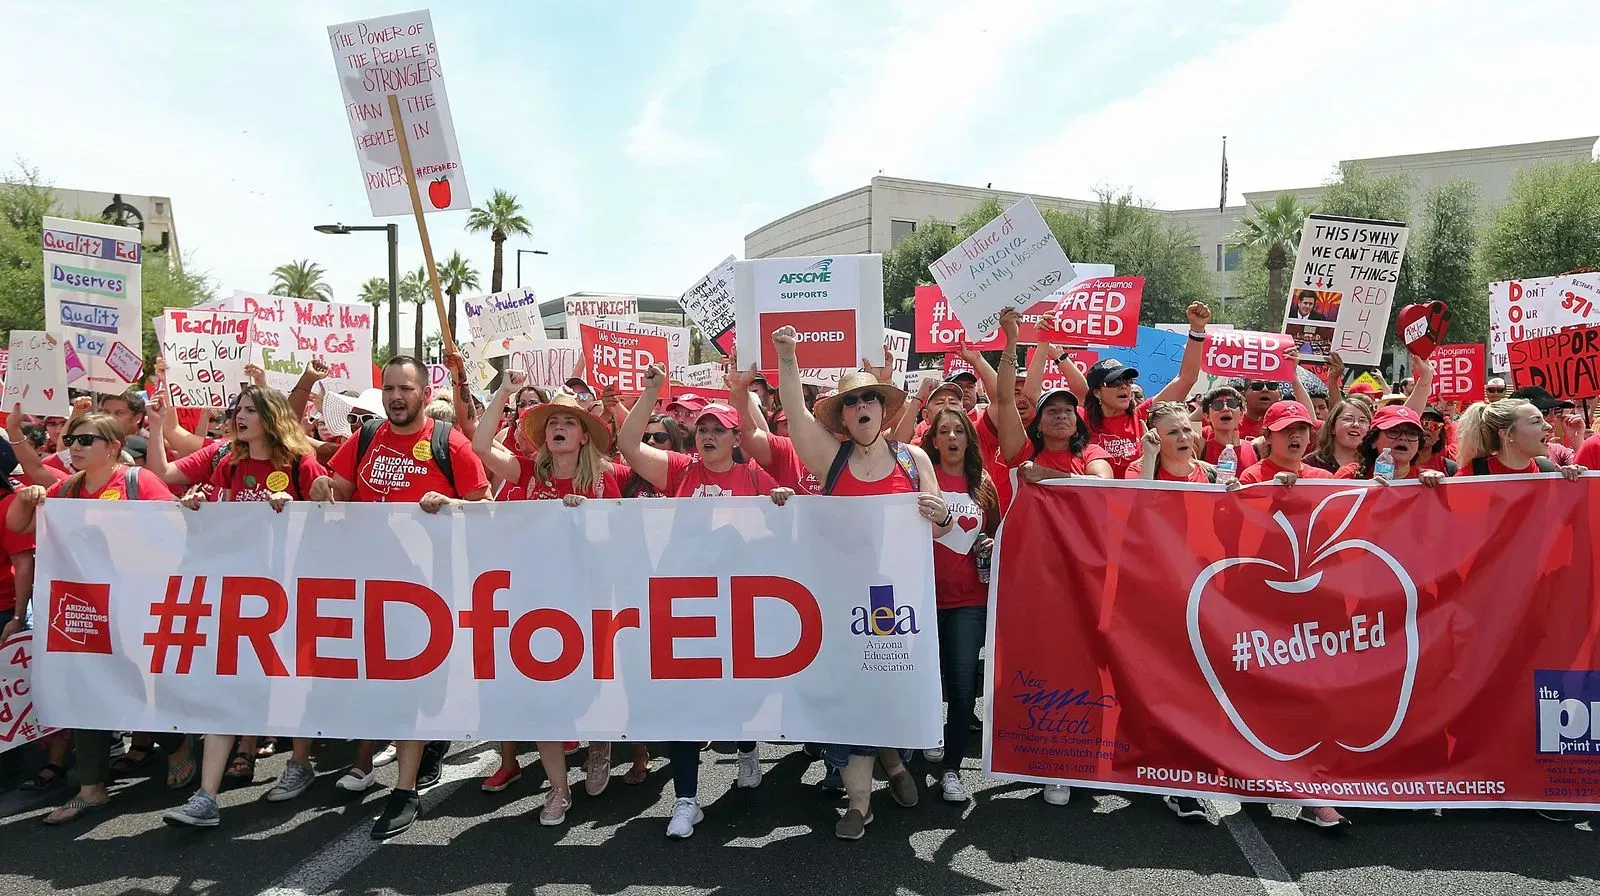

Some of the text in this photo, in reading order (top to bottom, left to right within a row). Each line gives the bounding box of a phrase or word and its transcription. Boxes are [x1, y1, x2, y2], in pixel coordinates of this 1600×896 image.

[330, 22, 425, 51] THE POWER OF
[345, 42, 436, 69] THE PEOPLE IS
[363, 58, 441, 92] STRONGER
[346, 94, 436, 122] THAN THE
[357, 121, 429, 150] PEOPLE IN
[366, 166, 408, 190] POWER
[416, 162, 458, 178] #REDFORED
[44, 232, 137, 260] Quality Ed
[1315, 225, 1399, 246] THIS IS WHY
[930, 214, 1015, 280] The future of
[1011, 233, 1055, 267] classroom
[1312, 246, 1331, 258] WE
[1372, 250, 1400, 265] HAVE
[53, 265, 122, 291] Deserves
[778, 271, 831, 284] AFSCME
[1304, 262, 1398, 283] NICE THINGS
[780, 291, 828, 299] SUPPORTS
[1092, 280, 1133, 291] Apoyamos
[1351, 286, 1387, 305] RED
[464, 290, 535, 318] Our Students
[566, 299, 637, 316] CARTWRIGHT
[690, 298, 702, 311] my
[708, 289, 730, 310] should
[712, 302, 729, 318] able
[977, 270, 1062, 333] SPEC ED 4 RED
[1059, 291, 1126, 313] #RED
[61, 305, 119, 327] Quality
[294, 301, 334, 328] Want
[489, 311, 523, 333] WORTH
[721, 311, 736, 328] FAM
[1052, 311, 1123, 336] forED
[1358, 309, 1371, 328] 4
[1508, 305, 1538, 323] OUR
[171, 311, 249, 344] Teaching
[796, 331, 845, 343] DFORED
[77, 334, 104, 355] Pay
[290, 326, 319, 351] You
[324, 333, 356, 354] Got
[598, 330, 639, 347] We Support
[1211, 333, 1280, 351] #RED
[1511, 329, 1600, 365] SUPPOR
[164, 339, 247, 361] Made Your
[593, 344, 655, 370] #RED
[1206, 346, 1280, 371] forED
[1438, 347, 1475, 357] Apoyamos
[1494, 353, 1508, 365] THE
[183, 361, 225, 383] Job
[1430, 357, 1473, 376] RED
[1512, 355, 1600, 399] EDUCAT
[1432, 376, 1473, 394] rED
[371, 470, 405, 481] UNITED
[373, 463, 428, 475] EDUCATORS
[65, 604, 97, 613] ARIZONA
[65, 612, 108, 622] EDUCATORS
[65, 620, 94, 628] UNITED
[65, 627, 99, 635] #REDFORED
[143, 570, 823, 680] #REDforED
[850, 605, 921, 636] aea
[866, 640, 903, 649] Arizona
[1232, 611, 1386, 671] #RedForEd
[10, 646, 32, 669] 4
[864, 650, 909, 660] Education
[861, 662, 915, 672] Association
[1012, 670, 1046, 689] New
[1539, 686, 1560, 699] the
[1017, 705, 1096, 735] Stitch
[998, 730, 1130, 752] Embroidery & Screen Printing
[1560, 740, 1590, 755] print
[1013, 744, 1114, 760] www.newstitch.net
[1028, 761, 1096, 773] (520) 741-1070
[1136, 766, 1506, 796] PROUD BUSINESSES SUPPORTING OUR TEACHERS
[1545, 788, 1571, 798] (520)
